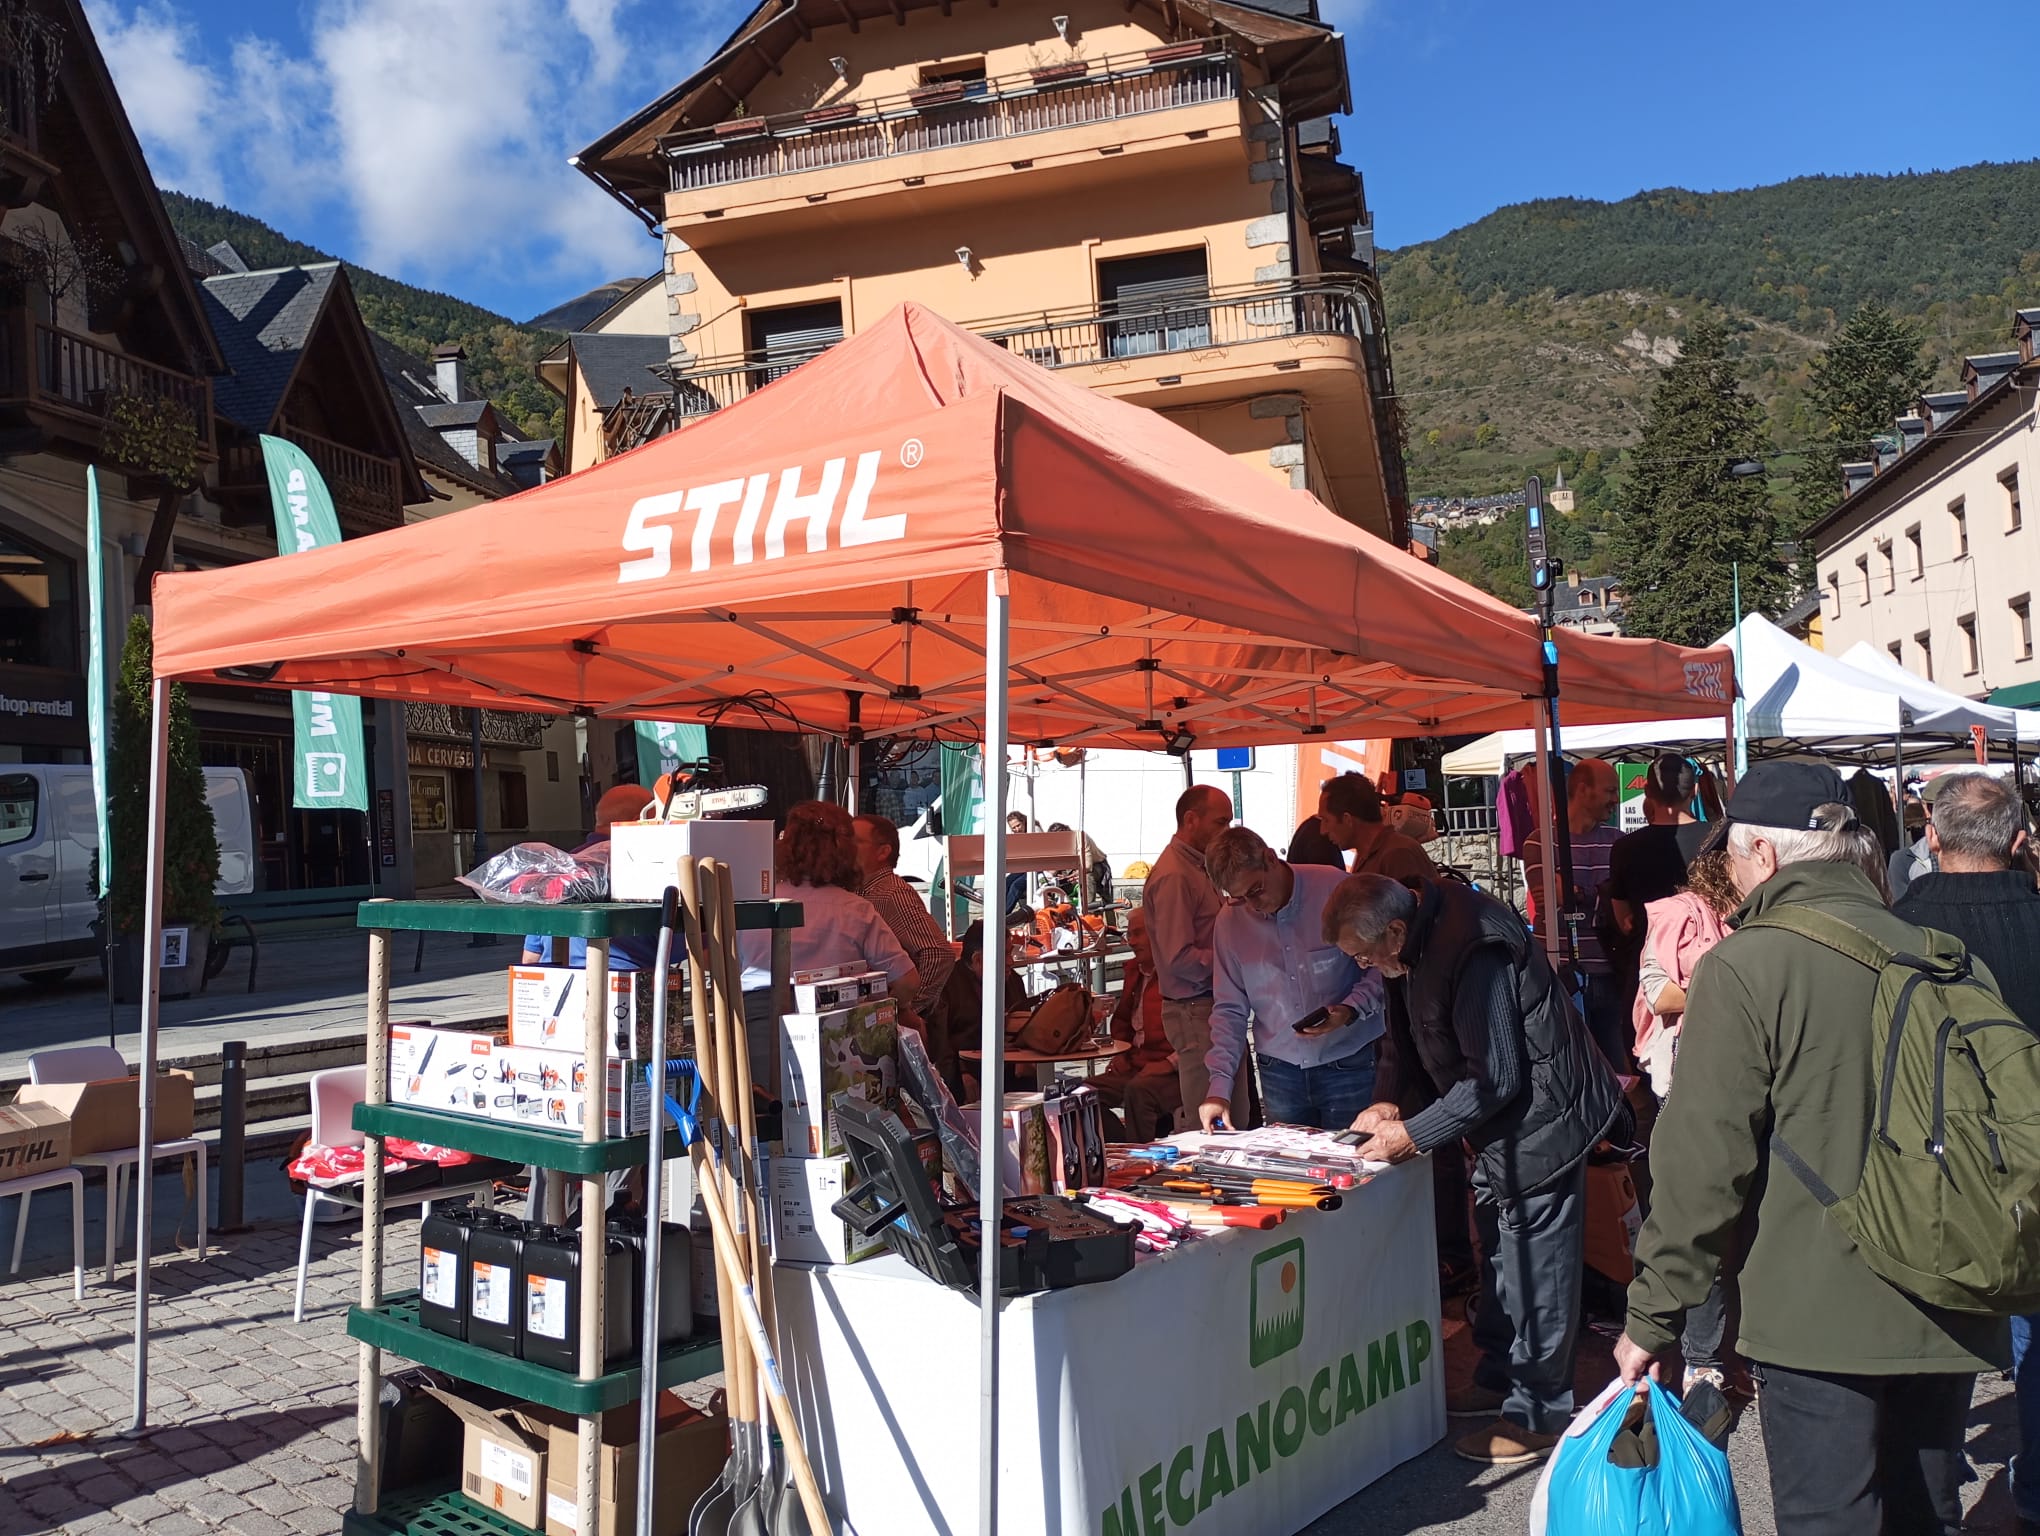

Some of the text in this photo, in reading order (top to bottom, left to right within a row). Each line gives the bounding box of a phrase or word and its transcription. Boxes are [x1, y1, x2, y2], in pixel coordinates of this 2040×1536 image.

[617, 450, 907, 584] STIHL
[427, 747, 488, 769] CERVESEA
[1625, 806, 1637, 815] LAS
[1101, 1319, 1432, 1536] MECANOCAMP
